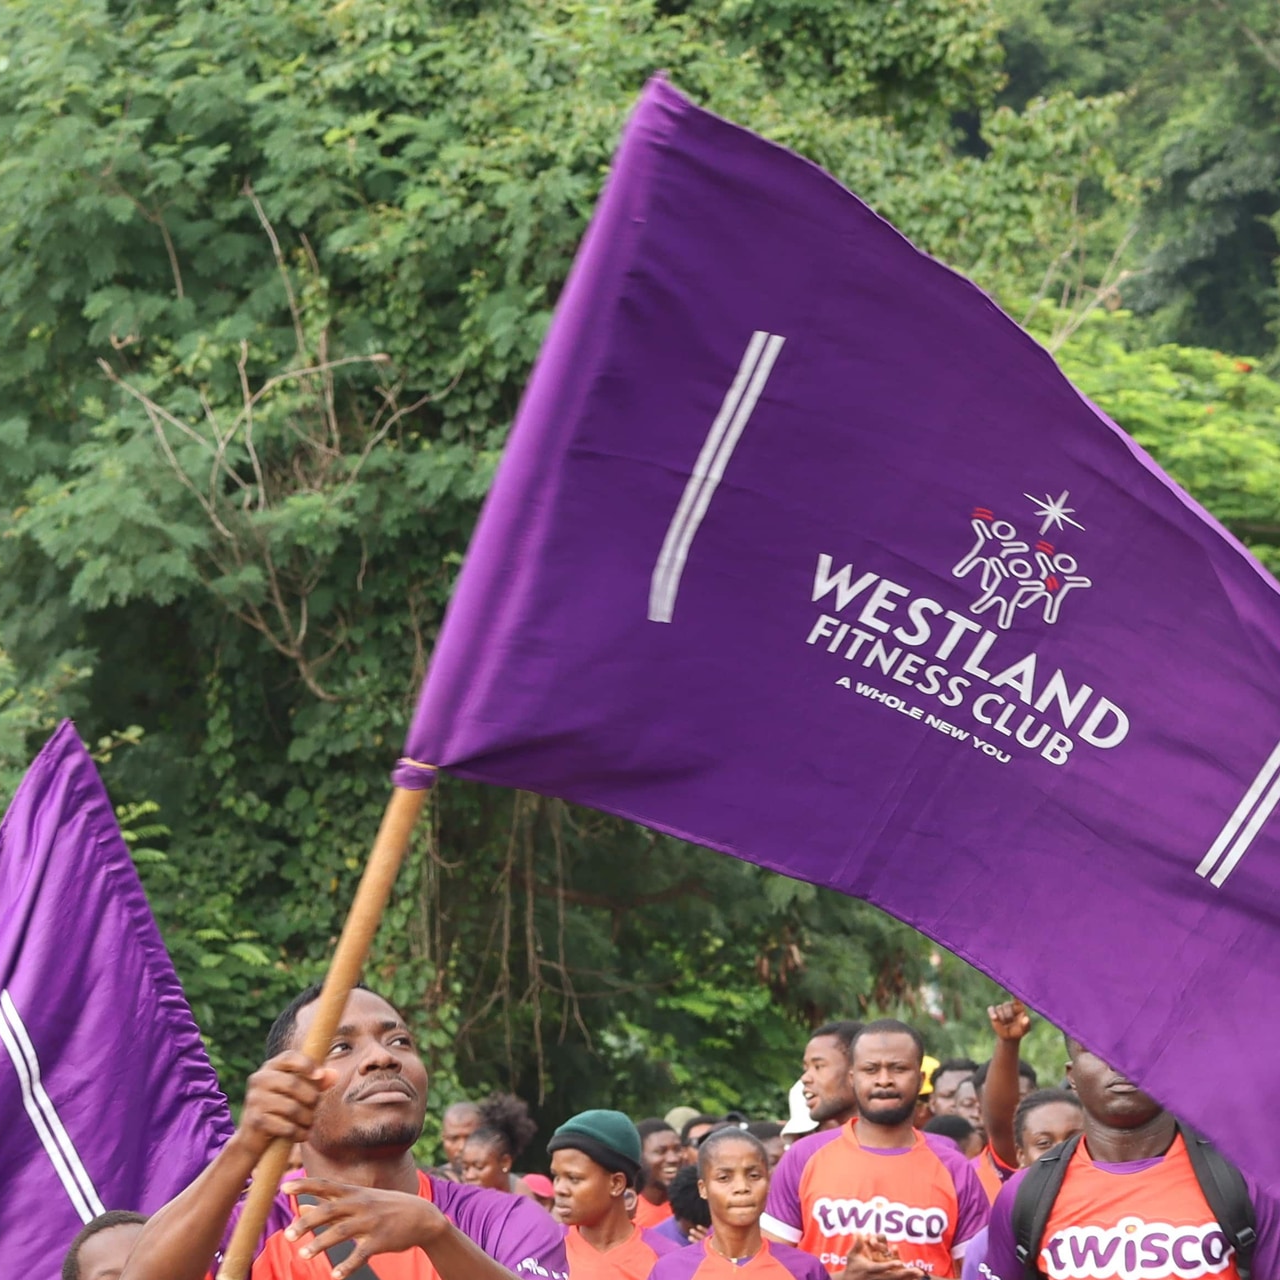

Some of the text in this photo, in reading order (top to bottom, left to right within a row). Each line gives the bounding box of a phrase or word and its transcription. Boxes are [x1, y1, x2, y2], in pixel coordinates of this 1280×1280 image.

[805, 613, 1075, 766] FITNESS CLUB
[811, 553, 1130, 749] WESTLAND
[834, 676, 1012, 764] A WHOLE NEW YOU
[819, 1199, 947, 1240] twisco
[1046, 1221, 1232, 1274] twisco
